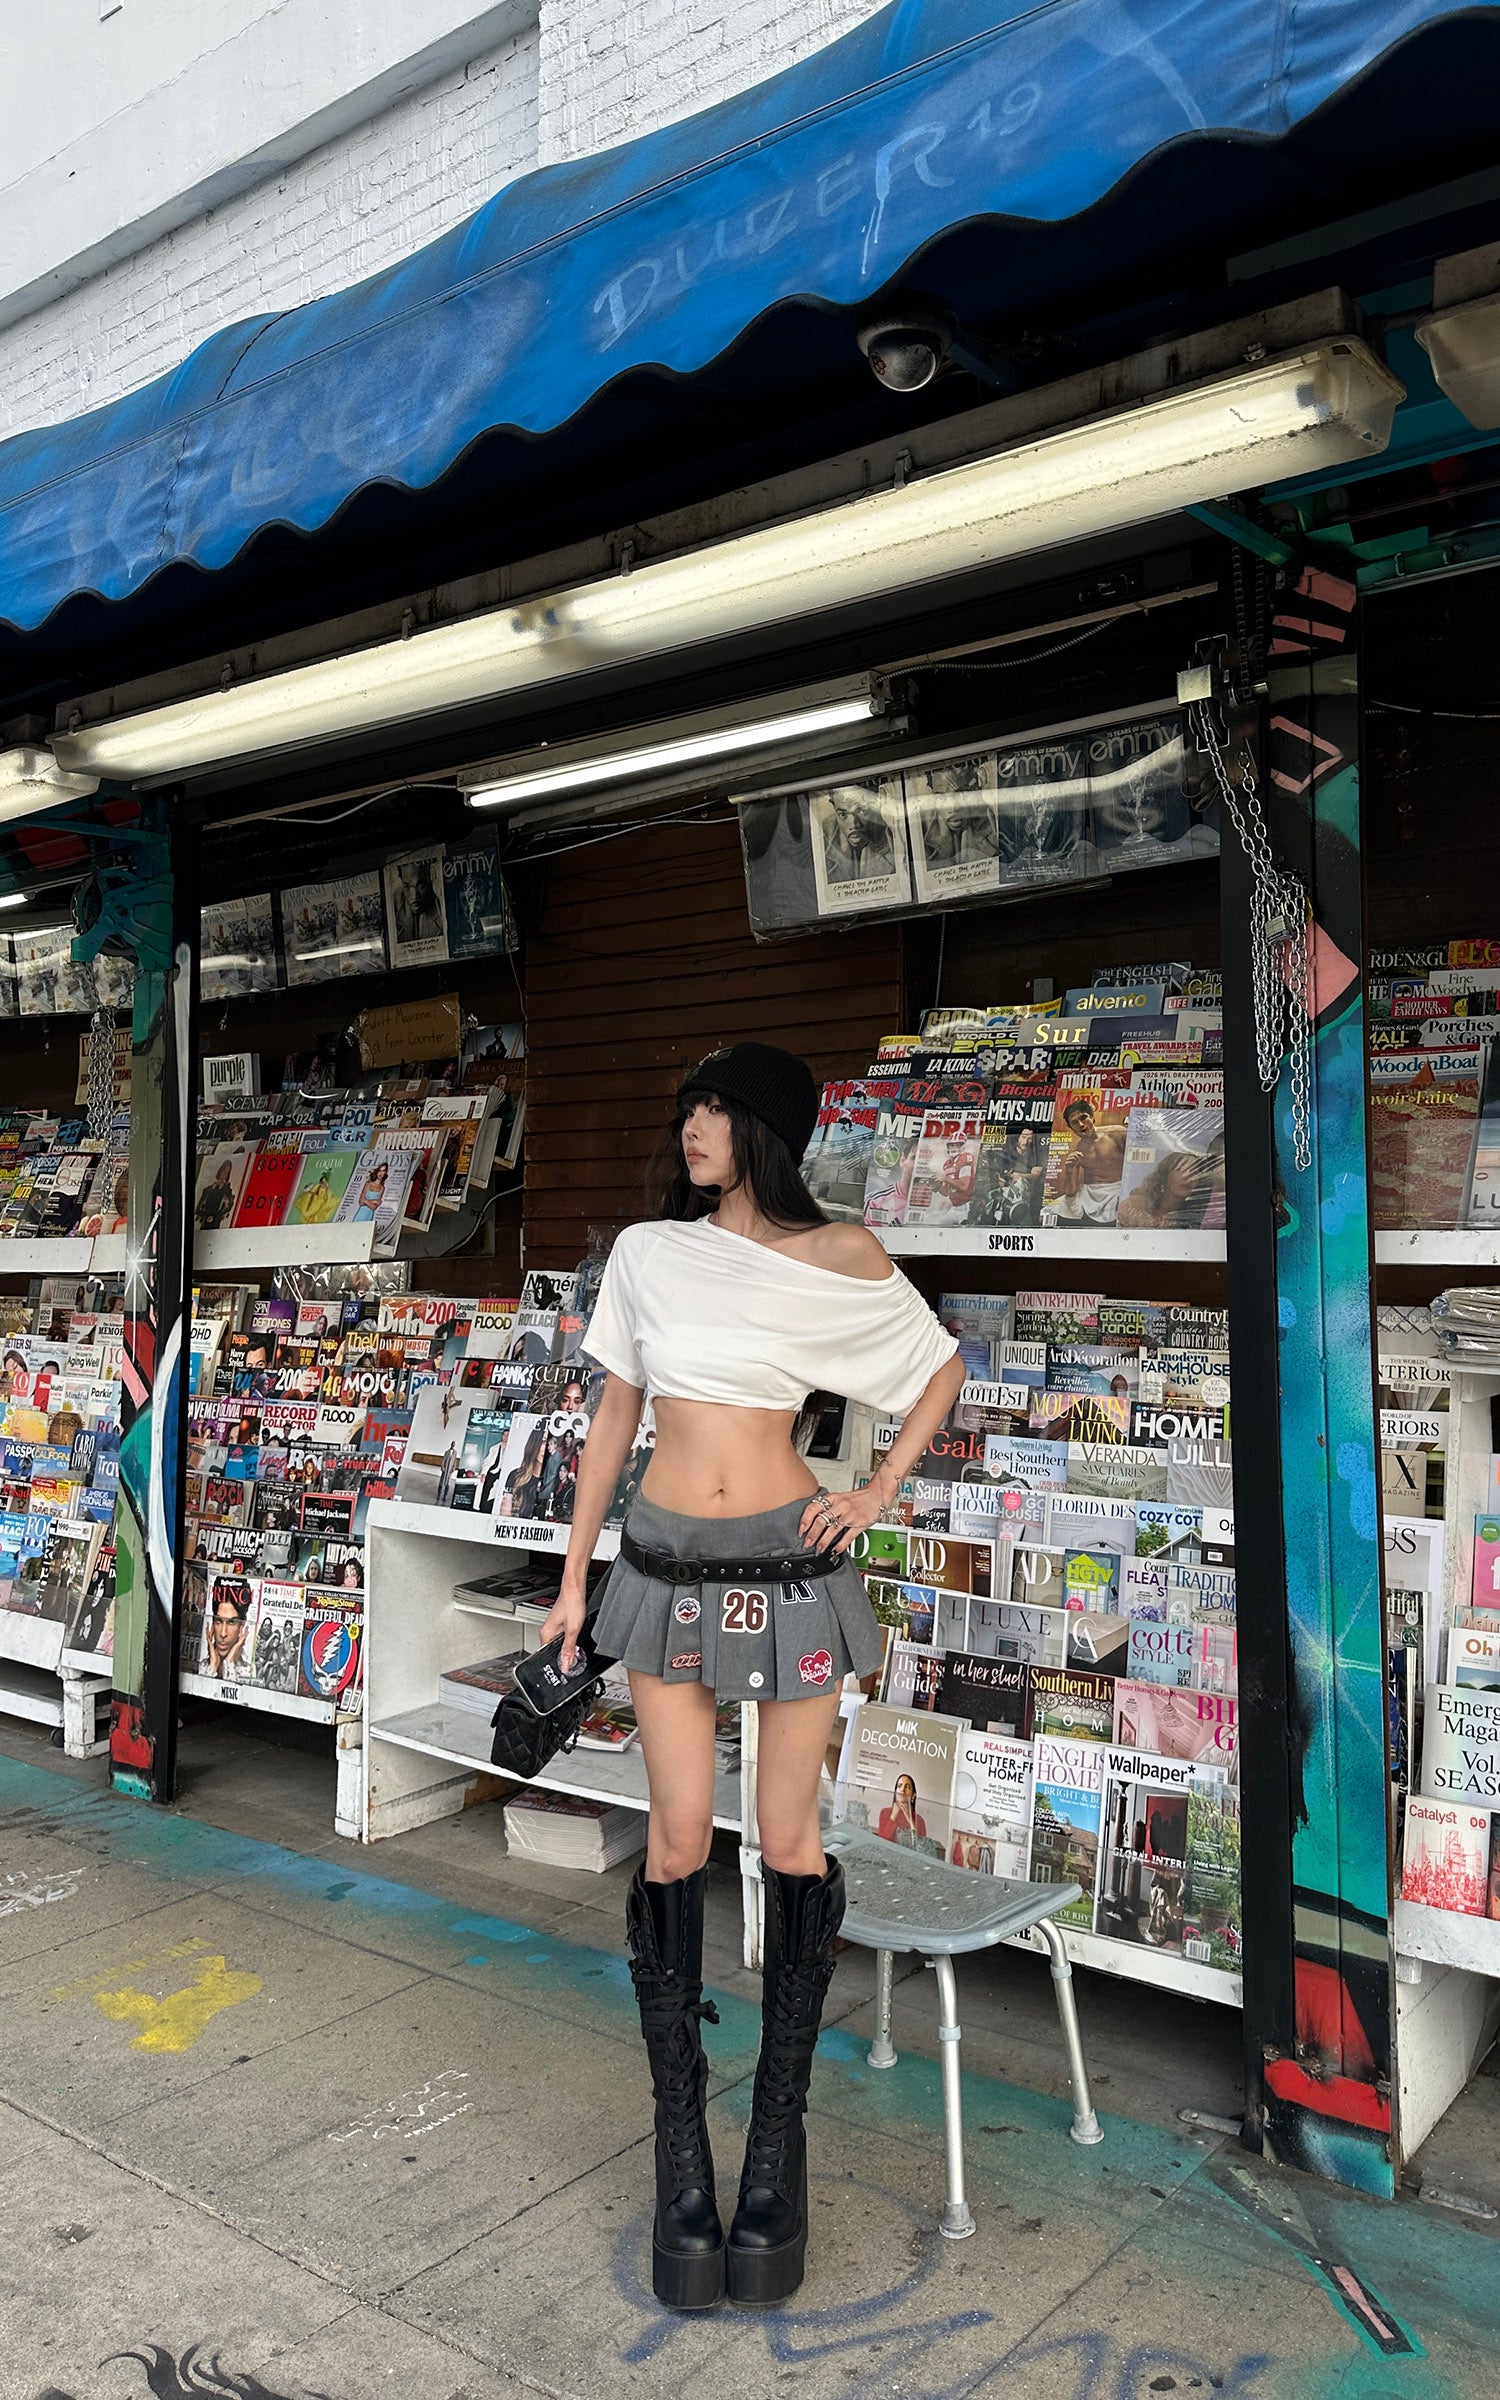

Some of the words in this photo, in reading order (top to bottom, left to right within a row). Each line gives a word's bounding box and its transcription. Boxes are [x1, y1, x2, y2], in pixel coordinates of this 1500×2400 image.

[1089, 724, 1179, 762] emmy
[998, 749, 1082, 778] emmy
[443, 853, 495, 879] emmy
[1116, 966, 1172, 978] ENGLISH
[1449, 973, 1474, 985] Fine
[1076, 993, 1148, 1011] alvento
[1168, 998, 1188, 1009] LIFE
[1405, 1001, 1438, 1010] MOTHER
[1394, 1008, 1421, 1016] EARTH
[1423, 1007, 1448, 1015] NEWS
[1428, 1019, 1494, 1034] Porches
[407, 1026, 445, 1046] Counter
[956, 1032, 1003, 1040] WORLD
[1033, 1023, 1087, 1046] Sur
[1122, 1042, 1152, 1050] TRAVEL
[1154, 1041, 1186, 1049] AWARDS
[926, 1059, 942, 1072] LA
[1055, 1051, 1082, 1066] NFL
[210, 1055, 246, 1087] purple
[1138, 1078, 1184, 1093] Athlon
[1055, 1089, 1100, 1112] Men's
[1101, 1090, 1160, 1112] Health
[426, 1100, 459, 1119] Cigar
[939, 1111, 961, 1120] SPORTS
[988, 1100, 1025, 1121] MEN'S
[984, 1126, 1006, 1135] KEANU
[375, 1130, 440, 1150] ARTFORUM
[983, 1134, 1006, 1144] REEVES
[257, 1158, 296, 1172] BOYS
[360, 1149, 412, 1168] GLADYS
[244, 1195, 284, 1209] BOYS
[988, 1234, 1034, 1251] SPORTS
[254, 1303, 268, 1313] SPIN
[426, 1302, 457, 1325] 200
[456, 1303, 477, 1312] Greatest
[456, 1311, 468, 1319] Goth
[252, 1317, 291, 1329] DEFTONES
[474, 1315, 512, 1331] FLOOD
[1016, 1312, 1048, 1325] Spring
[1101, 1309, 1147, 1323] atomic
[1101, 1322, 1146, 1335] ranch
[232, 1334, 249, 1345] People
[380, 1338, 403, 1351] DAVID
[406, 1339, 430, 1351] MUSIC
[1172, 1333, 1206, 1348] COUNTRY
[230, 1349, 245, 1359] Harry
[319, 1355, 335, 1366] Cher
[1004, 1347, 1045, 1365] UNIQUE
[1161, 1352, 1208, 1363] modern
[67, 1356, 85, 1369] Aging
[85, 1356, 99, 1368] Well
[1141, 1359, 1230, 1377] FARMHOUSE
[492, 1362, 533, 1387] HANK'S
[1169, 1375, 1200, 1386] style
[344, 1372, 395, 1396] MOJO
[243, 1406, 257, 1417] LIFE
[264, 1405, 317, 1421] RECORD
[1032, 1393, 1126, 1422] MOUNTAIN
[322, 1409, 355, 1424] FLOOD
[262, 1418, 316, 1432] COLLECTOR
[549, 1410, 591, 1440] GQ
[1135, 1412, 1223, 1440] HOME
[1069, 1420, 1125, 1446] LIVING
[74, 1433, 95, 1454] CABO
[72, 1453, 91, 1470] LIVING
[990, 1448, 1016, 1462] Best
[1082, 1443, 1157, 1466] VERANDA
[1010, 1462, 1050, 1477] Homes
[1082, 1464, 1146, 1478] SANCTUARIES
[1101, 1475, 1110, 1486] of
[1112, 1476, 1138, 1488] Beauty
[305, 1507, 326, 1517] Michael
[326, 1509, 350, 1519] Jackson
[1052, 1498, 1107, 1517] FLORIDA
[1110, 1504, 1136, 1518] DES
[920, 1510, 946, 1525] Design
[1139, 1509, 1173, 1524] COZY
[494, 1524, 518, 1541] MEN'S
[519, 1527, 555, 1543] FASHION
[912, 1538, 947, 1572] AD
[910, 1568, 945, 1583] Collector
[1013, 1552, 1052, 1585] AD
[1067, 1564, 1114, 1584] HGTV
[1067, 1580, 1097, 1591] magazine
[1127, 1571, 1160, 1586] FLEA
[279, 1588, 296, 1598] TIME
[879, 1586, 931, 1613] LUX
[263, 1597, 292, 1609] Grateful
[305, 1608, 343, 1623] GRATEFUL
[345, 1611, 364, 1627] DEAD
[723, 1590, 767, 1634] 26
[981, 1605, 1050, 1637] LUXE
[1465, 1639, 1493, 1657] Oh
[897, 1653, 923, 1674] The
[1132, 1648, 1174, 1665] STYLE
[953, 1660, 965, 1676] in
[967, 1659, 988, 1682] her
[893, 1672, 939, 1695] Guide
[1030, 1669, 1093, 1700] Southern
[1117, 1681, 1133, 1691] Better
[221, 1686, 238, 1700] MUSIC
[1197, 1695, 1235, 1726] BH
[861, 1729, 948, 1760] DECORATION
[1214, 1725, 1234, 1751] G
[984, 1741, 1003, 1752] REAL
[988, 1767, 1024, 1784] HOME
[1037, 1764, 1098, 1790] HOME
[1044, 1786, 1078, 1800] BRIGHT
[1081, 1793, 1088, 1801] &
[1409, 1804, 1457, 1826] Catalyst
[1060, 1910, 1070, 1920] OF
